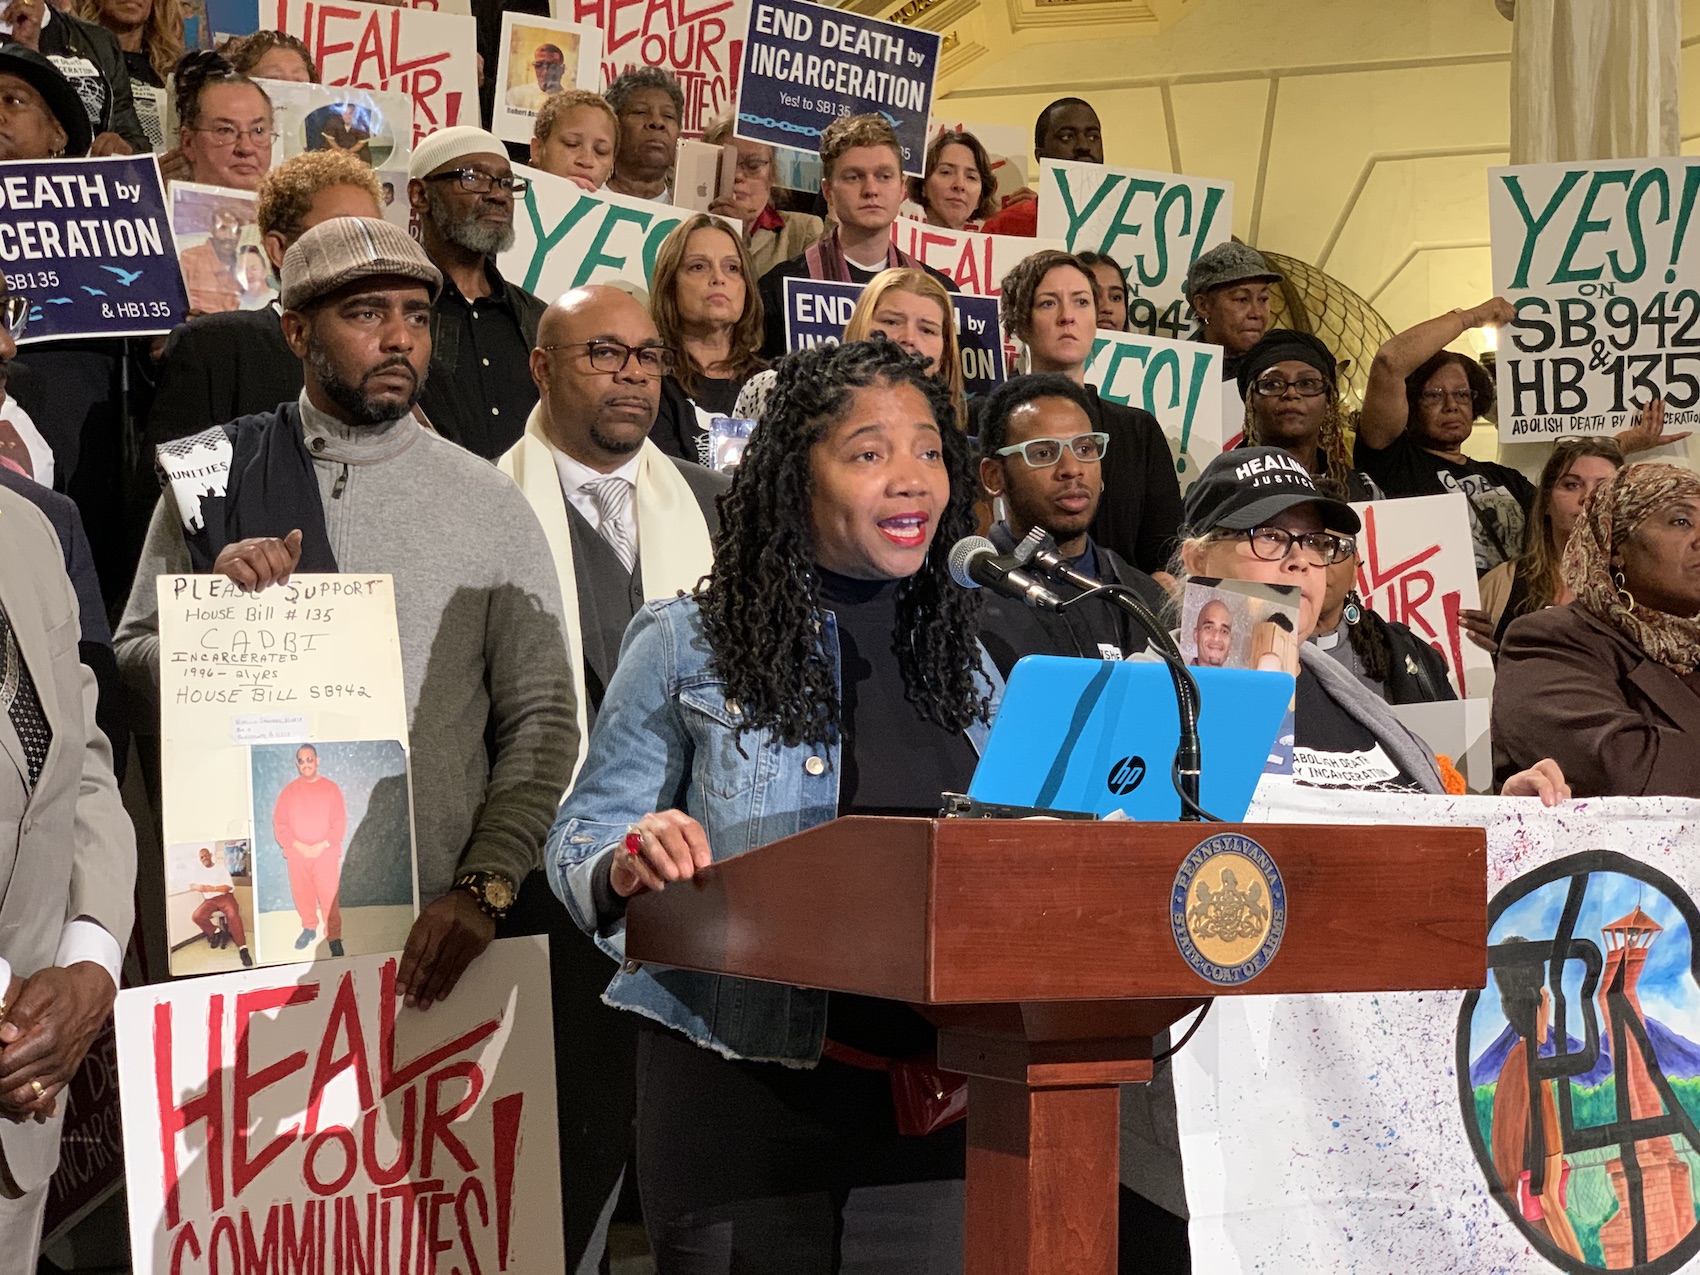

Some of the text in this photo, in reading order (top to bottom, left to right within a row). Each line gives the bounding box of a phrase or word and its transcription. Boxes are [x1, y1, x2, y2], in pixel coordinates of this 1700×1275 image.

[640, 18, 723, 73] OUR
[756, 4, 925, 67] END DEATH by
[751, 43, 926, 113] INCARCERATION
[779, 92, 850, 118] Yes! to SB135
[115, 181, 141, 203] by
[1051, 167, 1225, 294] YES!
[1500, 166, 1700, 289] YES!
[5, 271, 60, 290] SB135
[1578, 282, 1616, 299] ON
[102, 302, 171, 318] & HB135
[796, 293, 857, 325] END
[967, 315, 986, 335] by
[1589, 339, 1611, 370] &
[1512, 418, 1563, 435] ABOLISH
[1570, 415, 1605, 432] DEATH
[1612, 415, 1625, 428] BY
[174, 577, 383, 604] PLEAS SUPPORT
[285, 609, 297, 620] #
[306, 608, 334, 622] 135
[171, 652, 299, 664] INCARCERATED
[177, 684, 372, 704] HOUSE BILL SB942
[1110, 756, 1144, 795] hp
[1177, 837, 1279, 890] PENNSYLVANIA
[1173, 909, 1283, 982] STATE COAT OF ARMS
[153, 957, 503, 1230] HEAL
[303, 1061, 484, 1196] OUR
